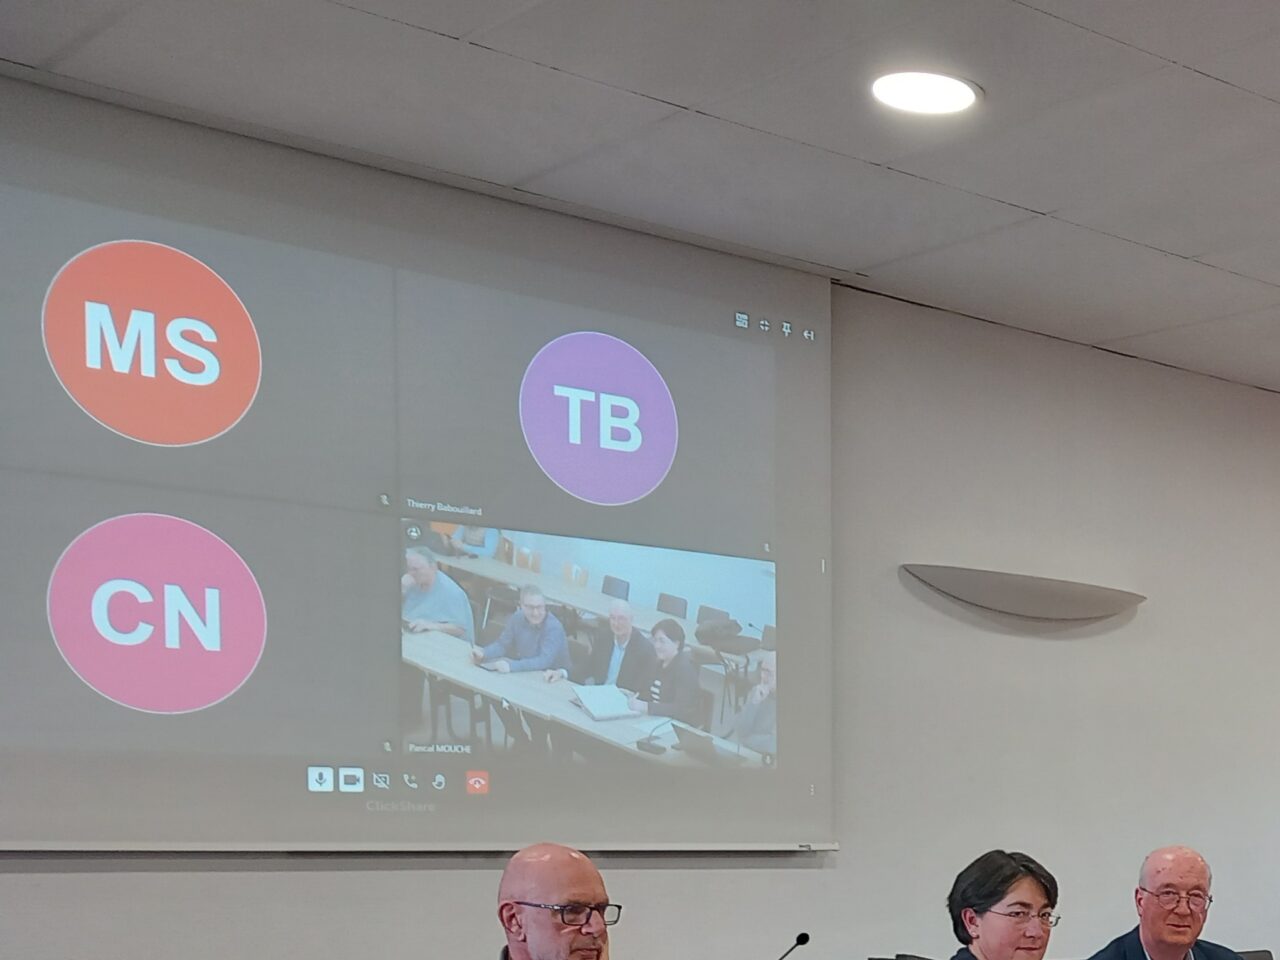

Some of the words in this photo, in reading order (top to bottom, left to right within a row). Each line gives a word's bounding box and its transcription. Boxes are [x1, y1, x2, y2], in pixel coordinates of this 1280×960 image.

[83, 301, 221, 387] MS
[552, 384, 644, 454] TB
[407, 498, 436, 512] Thierry
[90, 579, 222, 653] CN
